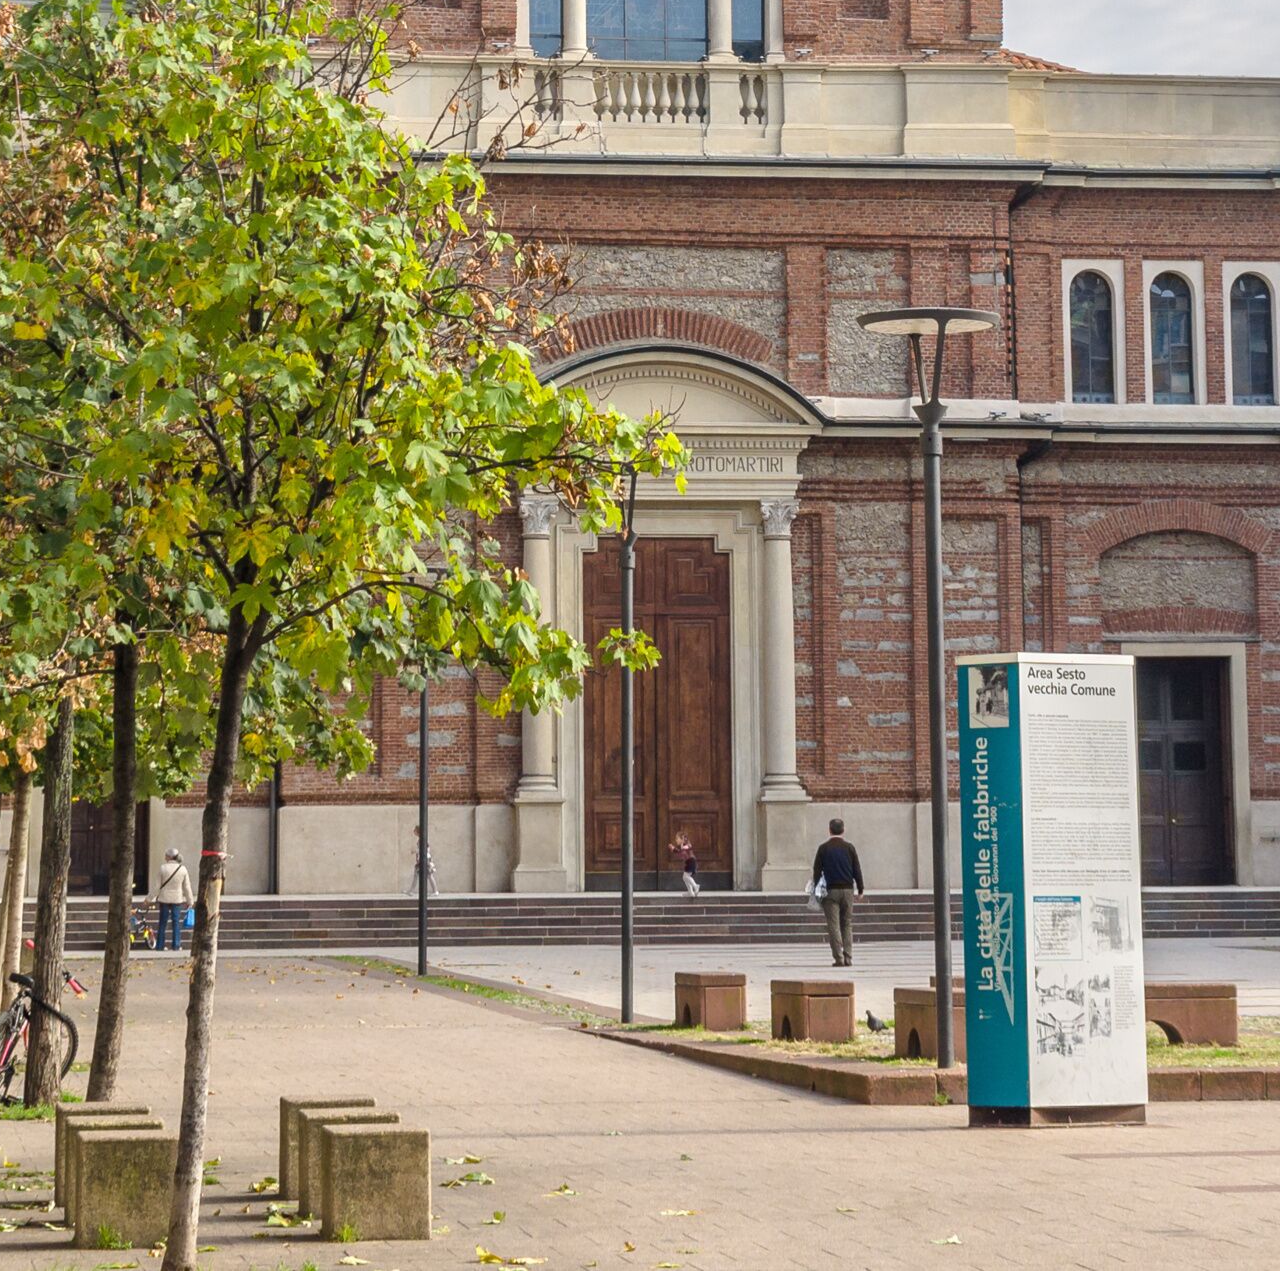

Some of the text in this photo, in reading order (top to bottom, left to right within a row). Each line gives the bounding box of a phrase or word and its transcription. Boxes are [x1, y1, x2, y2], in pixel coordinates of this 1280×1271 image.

[677, 456, 784, 473] ROTOMARTIRI
[1027, 666, 1086, 680] Area Sesto
[1027, 682, 1116, 697] vecchia Comune
[990, 827, 998, 842] del
[971, 737, 994, 991] La città delle fabbriche
[991, 844, 999, 885] Giovanni
